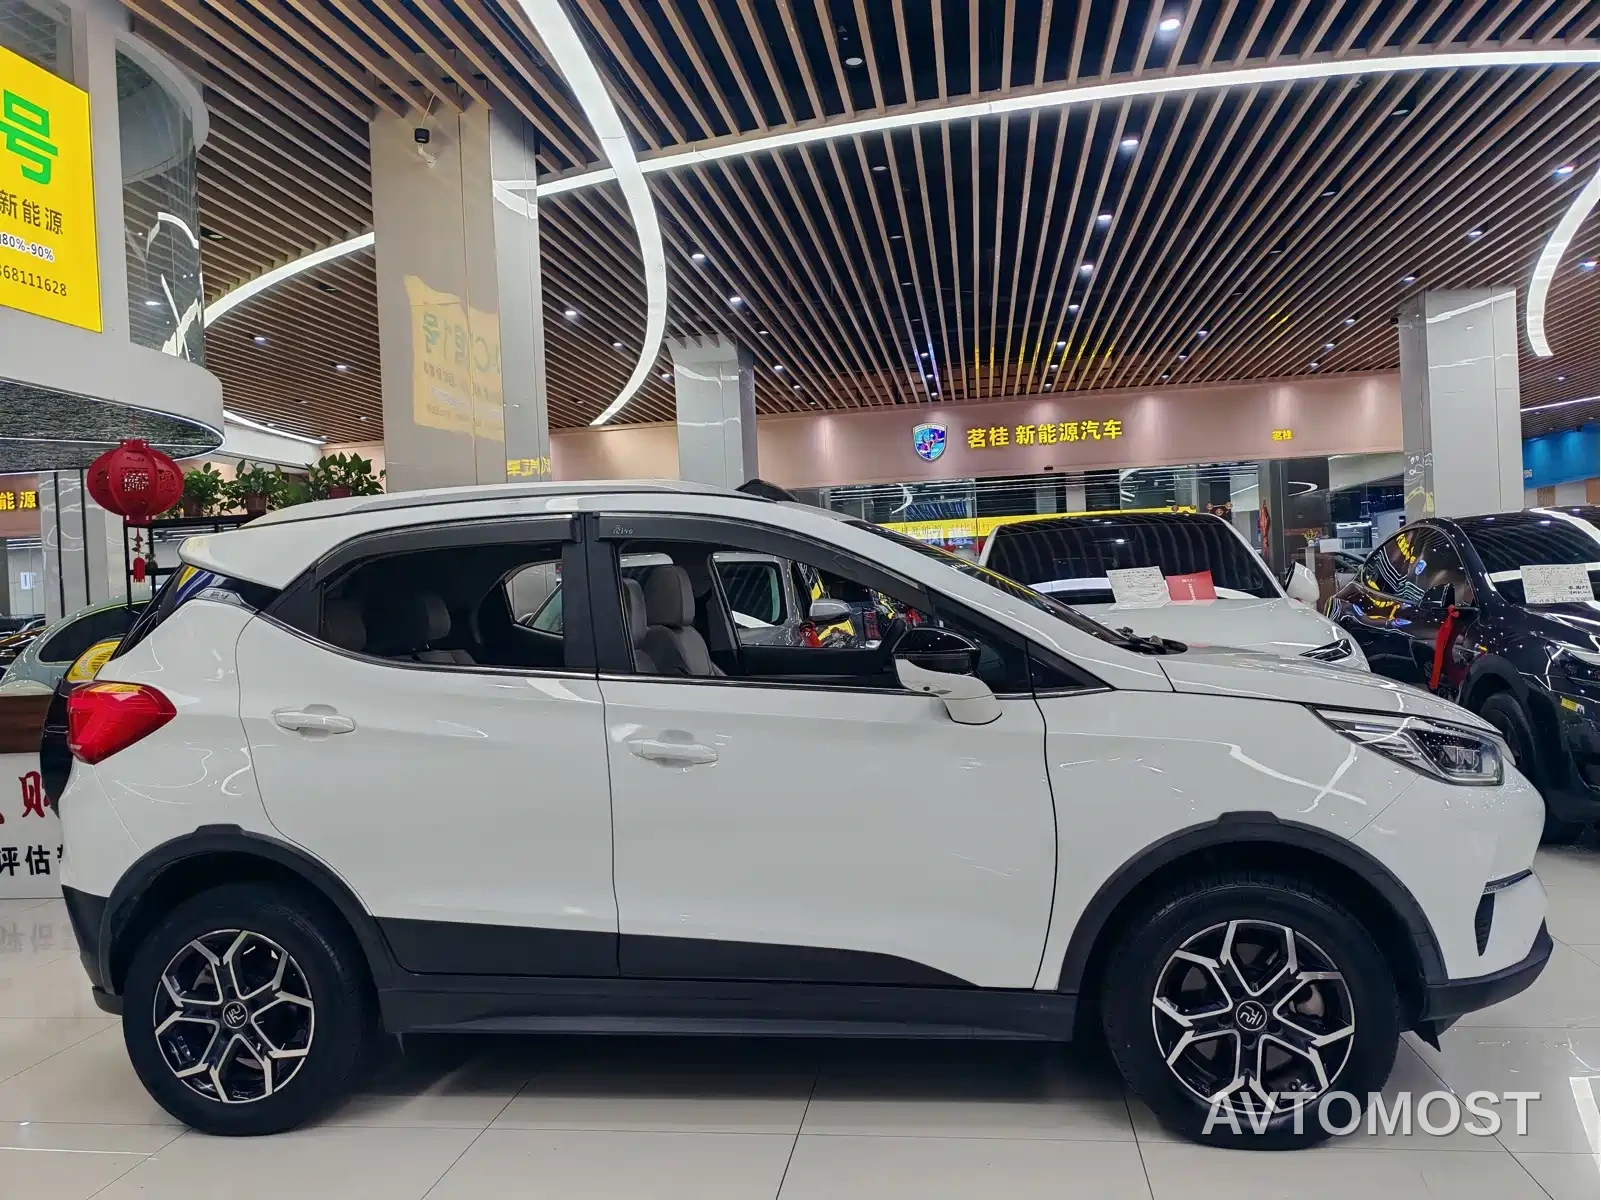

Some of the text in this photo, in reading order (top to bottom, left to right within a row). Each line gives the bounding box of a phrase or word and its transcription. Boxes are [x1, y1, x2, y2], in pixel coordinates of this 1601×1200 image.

[0, 88, 58, 184] 号
[0, 190, 63, 235] 新能源
[0, 233, 54, 261] 80%-90%
[967, 419, 1123, 449] 茗桂 新能源汽车
[0, 491, 37, 510] 能源
[0, 844, 63, 876] 评估
